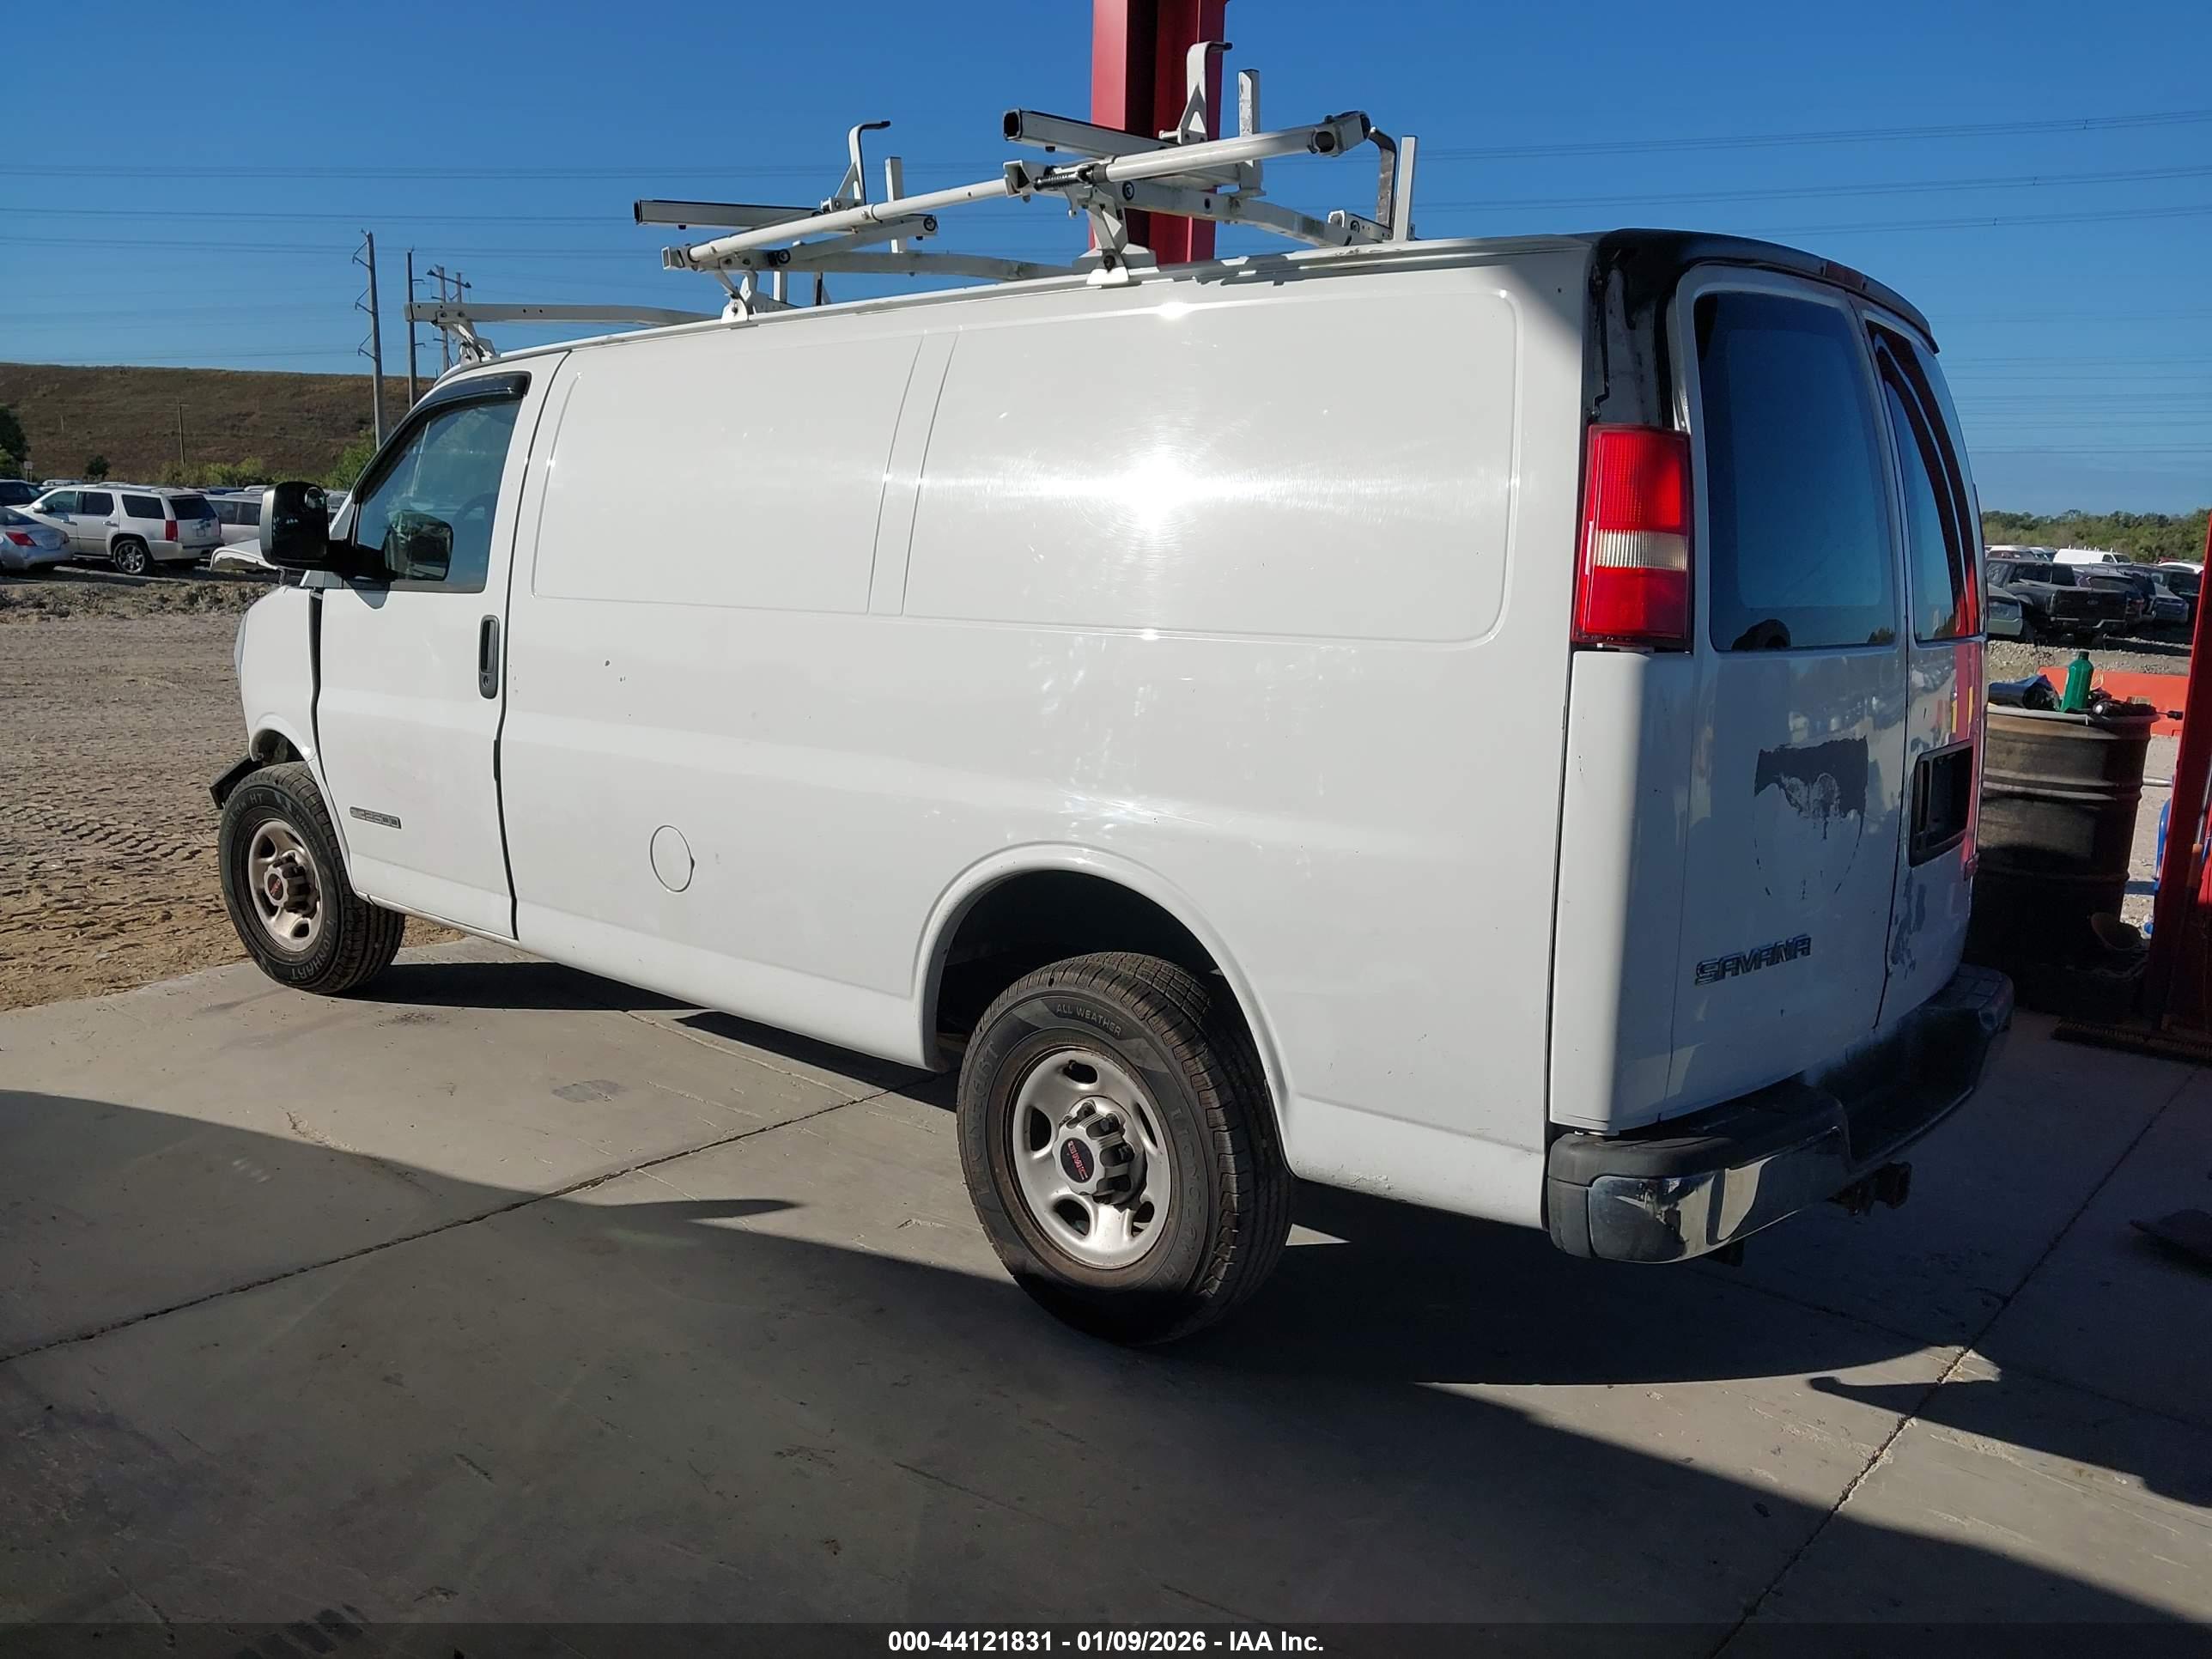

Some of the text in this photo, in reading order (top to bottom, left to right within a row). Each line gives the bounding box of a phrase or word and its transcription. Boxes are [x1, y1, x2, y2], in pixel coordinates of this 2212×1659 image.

[1694, 933, 1813, 987] SAVANA
[1056, 1003, 1122, 1037] ALL WEATHER
[1067, 1140, 1088, 1180] GMC
